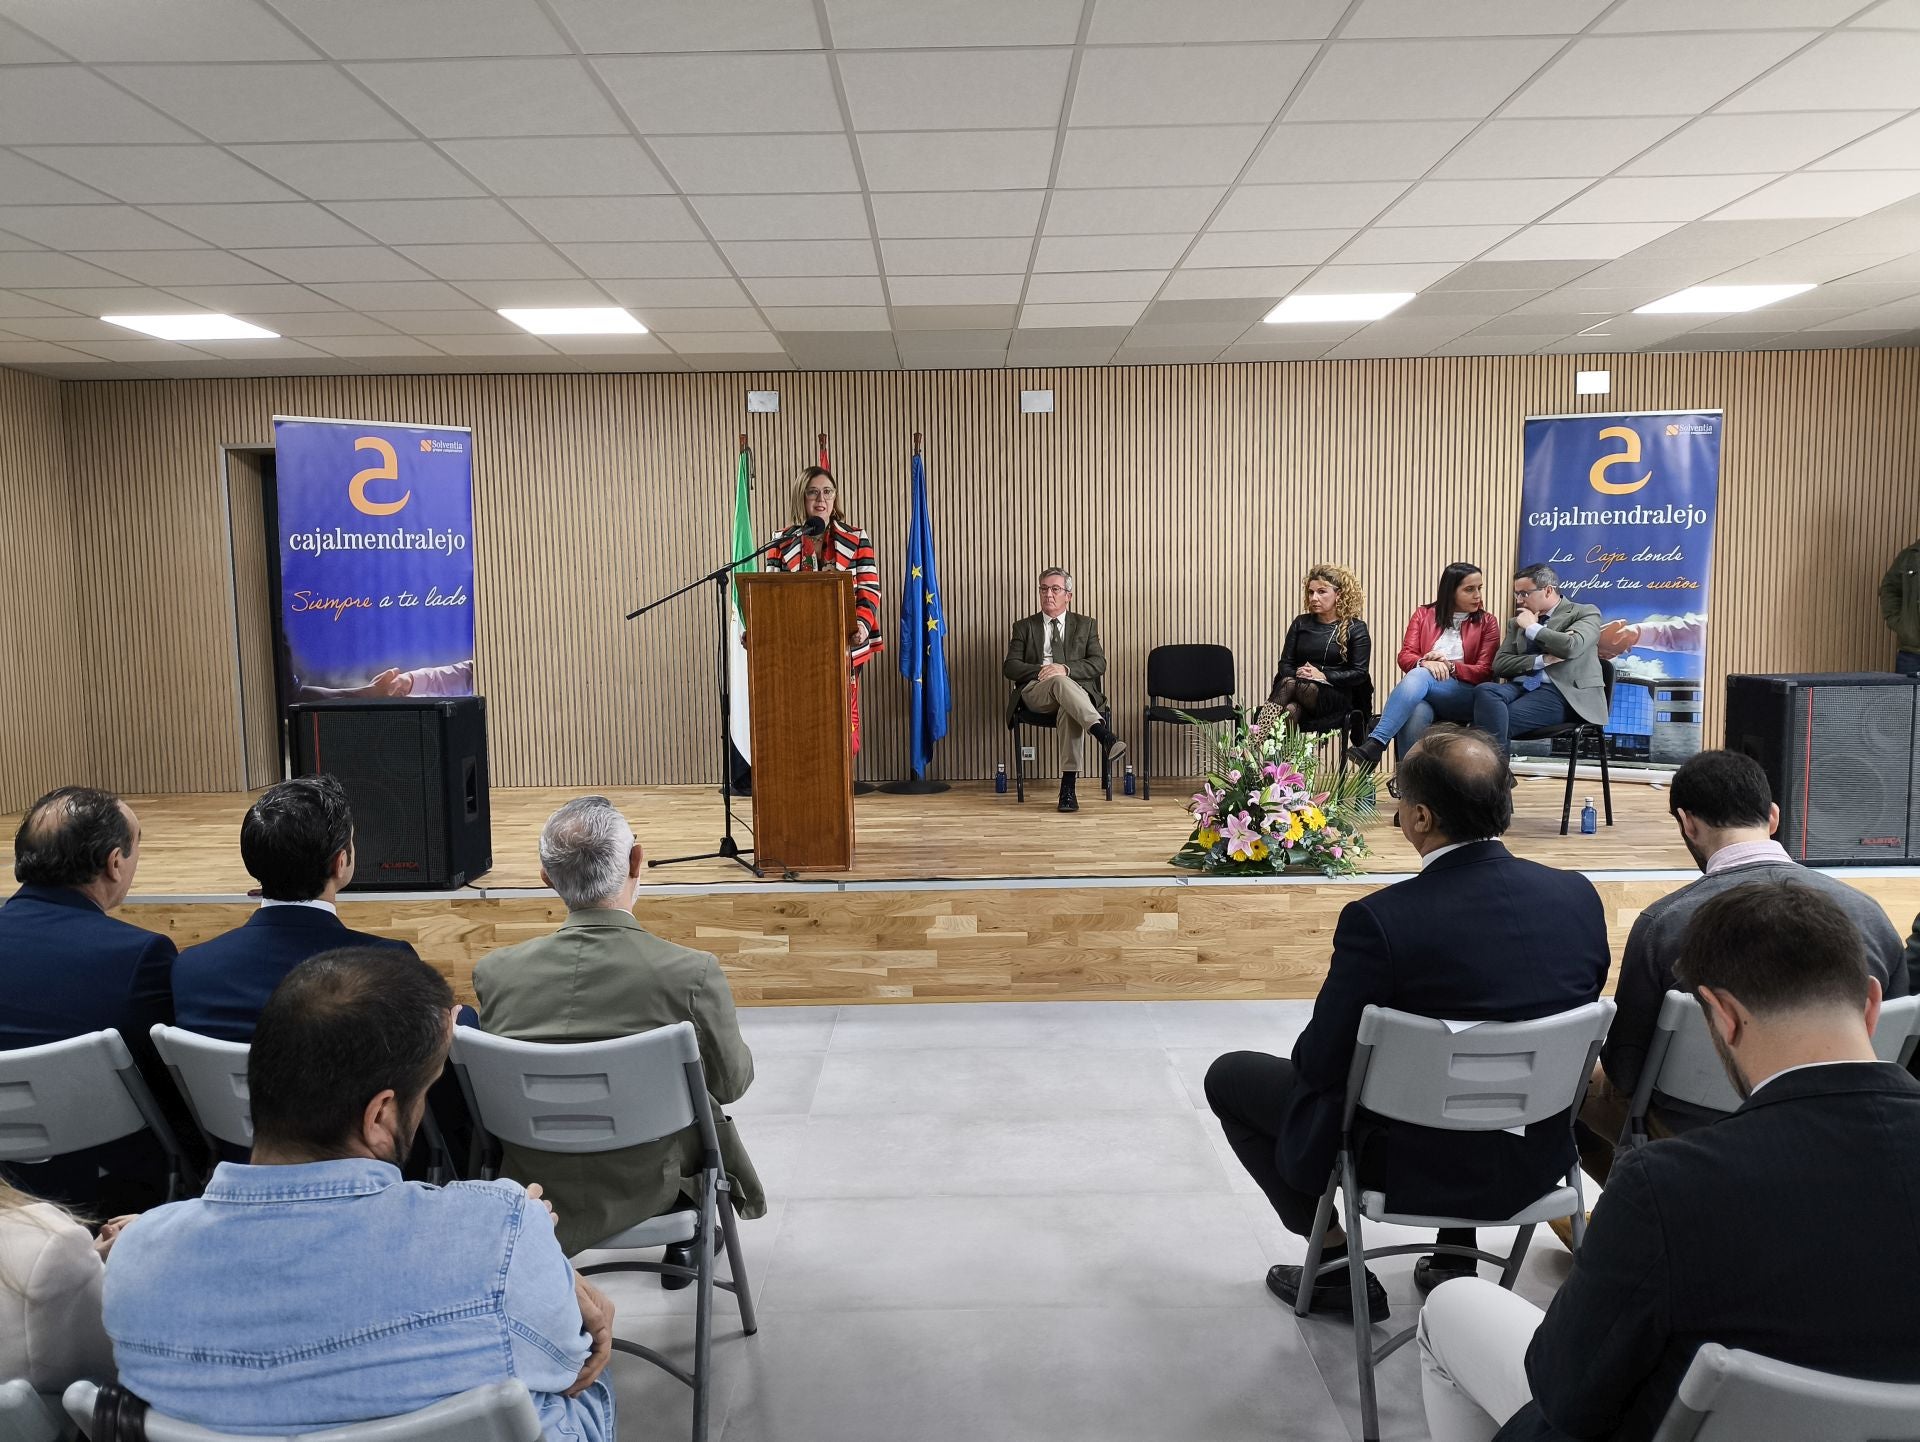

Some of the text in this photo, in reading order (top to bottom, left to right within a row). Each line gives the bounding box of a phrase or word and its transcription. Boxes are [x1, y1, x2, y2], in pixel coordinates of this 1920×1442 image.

[432, 440, 463, 450] Solventia
[1528, 504, 1707, 531] cajalmendralejo
[289, 527, 466, 557] cajalmendralejo
[1549, 544, 1684, 573] La Caja donde
[1559, 574, 1701, 598] umplen tus sueños
[291, 585, 468, 622] Siempre a tu lado
